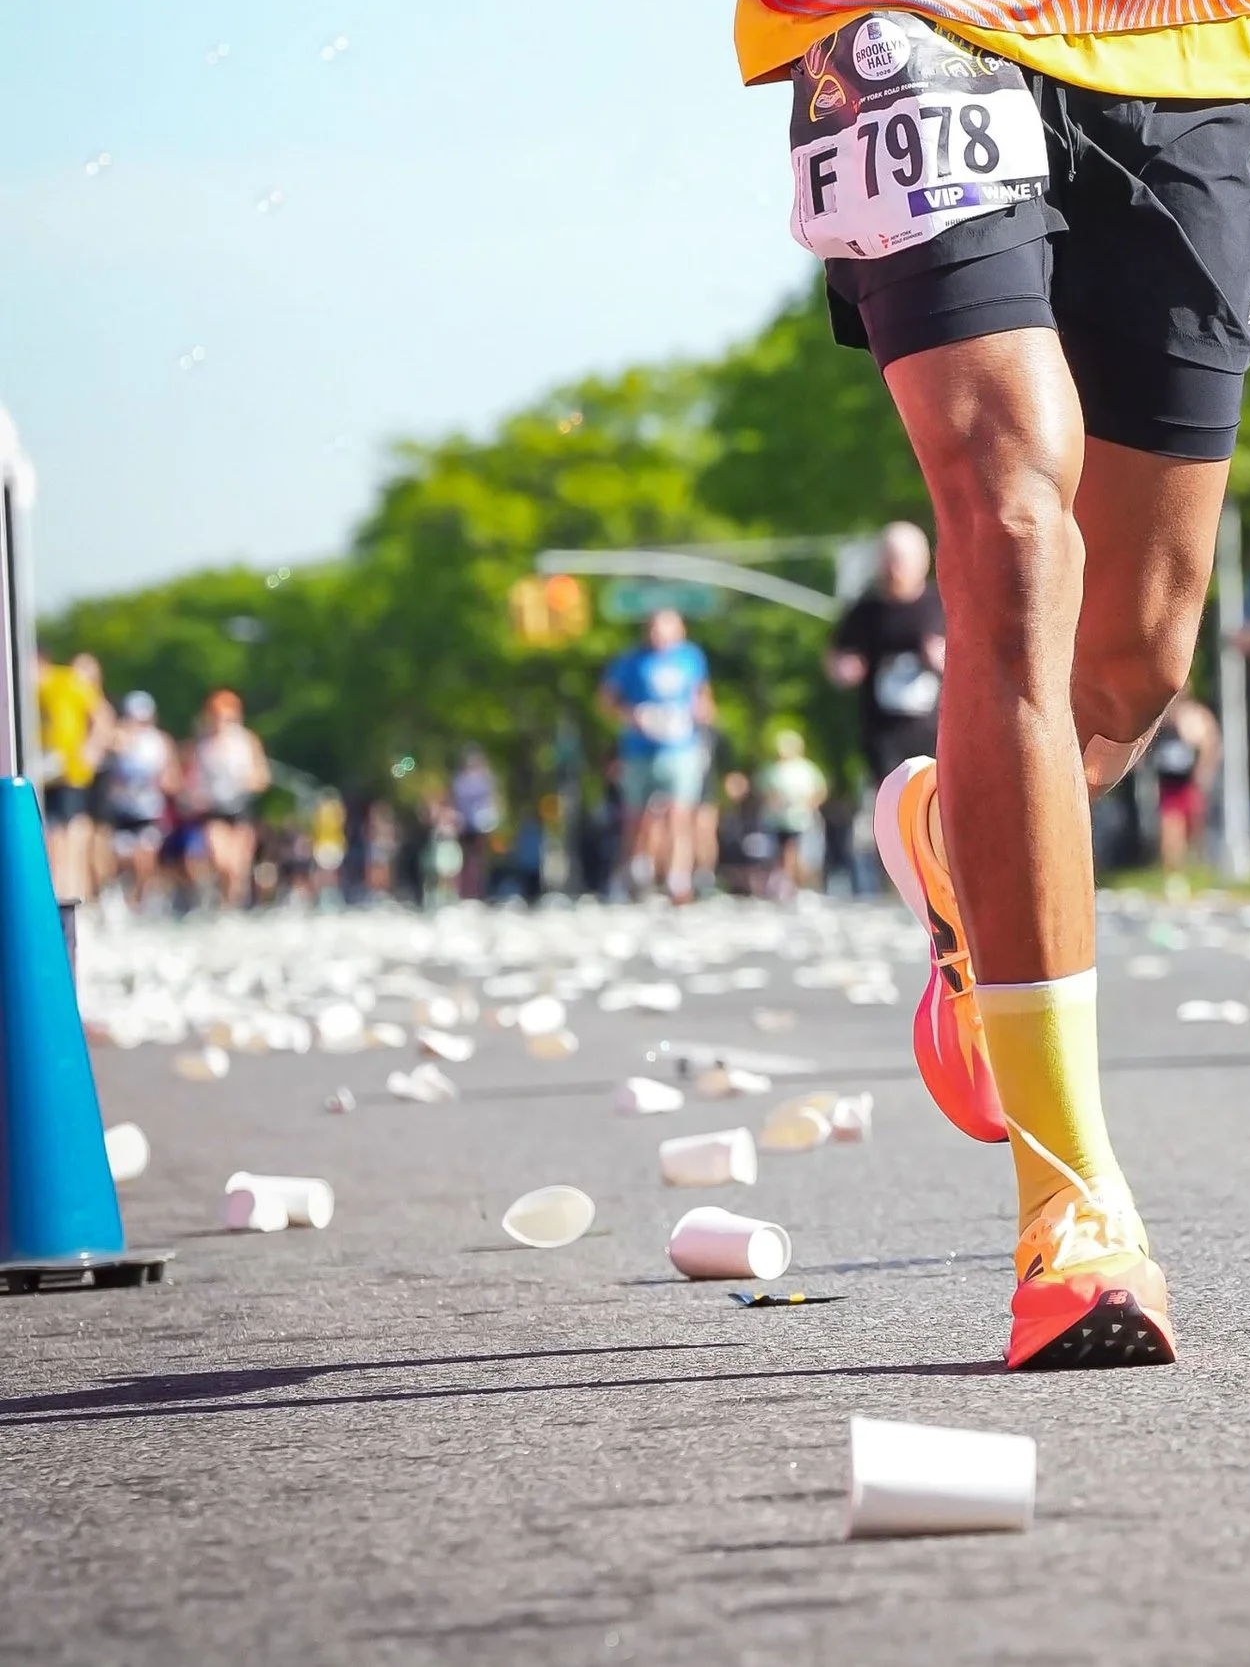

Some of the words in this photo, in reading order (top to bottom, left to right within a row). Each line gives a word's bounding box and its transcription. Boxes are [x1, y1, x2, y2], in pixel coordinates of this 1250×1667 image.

[867, 53, 893, 70] HALF
[866, 91, 883, 101] YORK
[883, 86, 900, 96] ROAD
[809, 147, 838, 215] F
[857, 104, 1000, 199] 7978
[923, 187, 964, 208] VIP
[982, 183, 1031, 202] WAVE
[1035, 182, 1042, 196] 1
